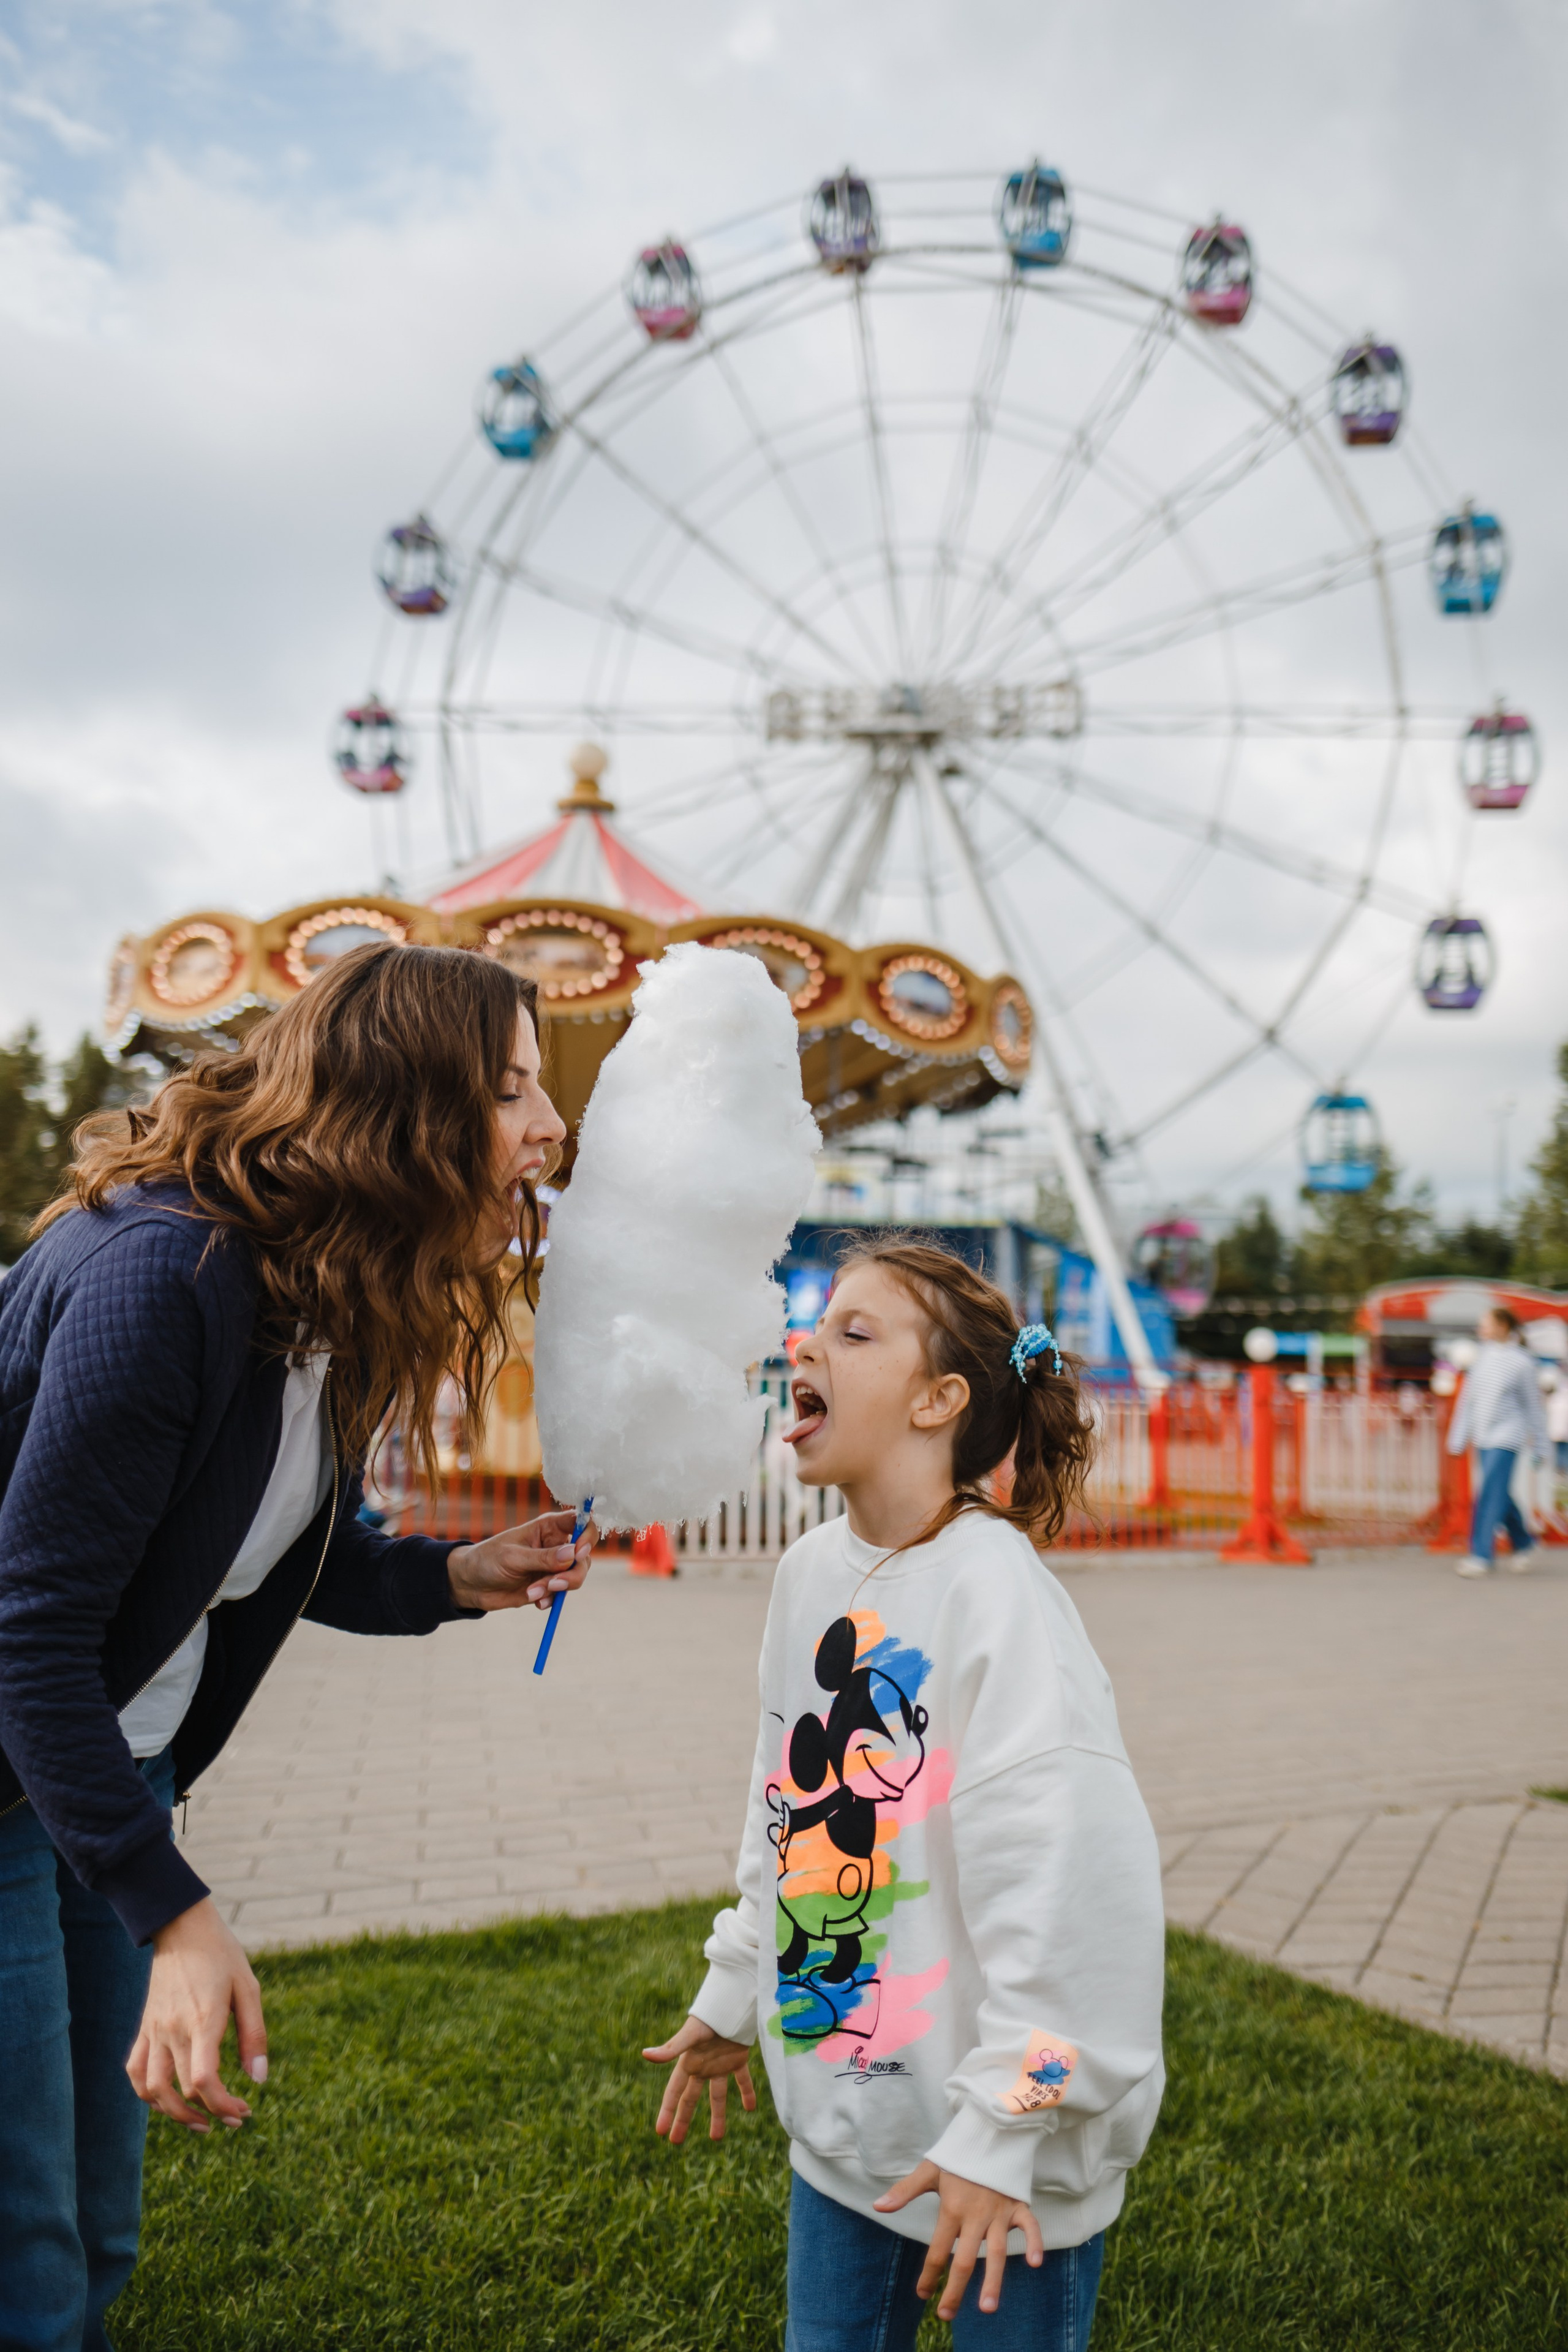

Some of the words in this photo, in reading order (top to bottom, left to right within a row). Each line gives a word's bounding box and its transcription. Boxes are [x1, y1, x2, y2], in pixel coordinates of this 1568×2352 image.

[868, 2060, 905, 2072] MOUSE
[1027, 2072, 1044, 2087] FEEL
[1046, 2084, 1061, 2100] COOL
[1030, 2085, 1049, 2100] VIBES
